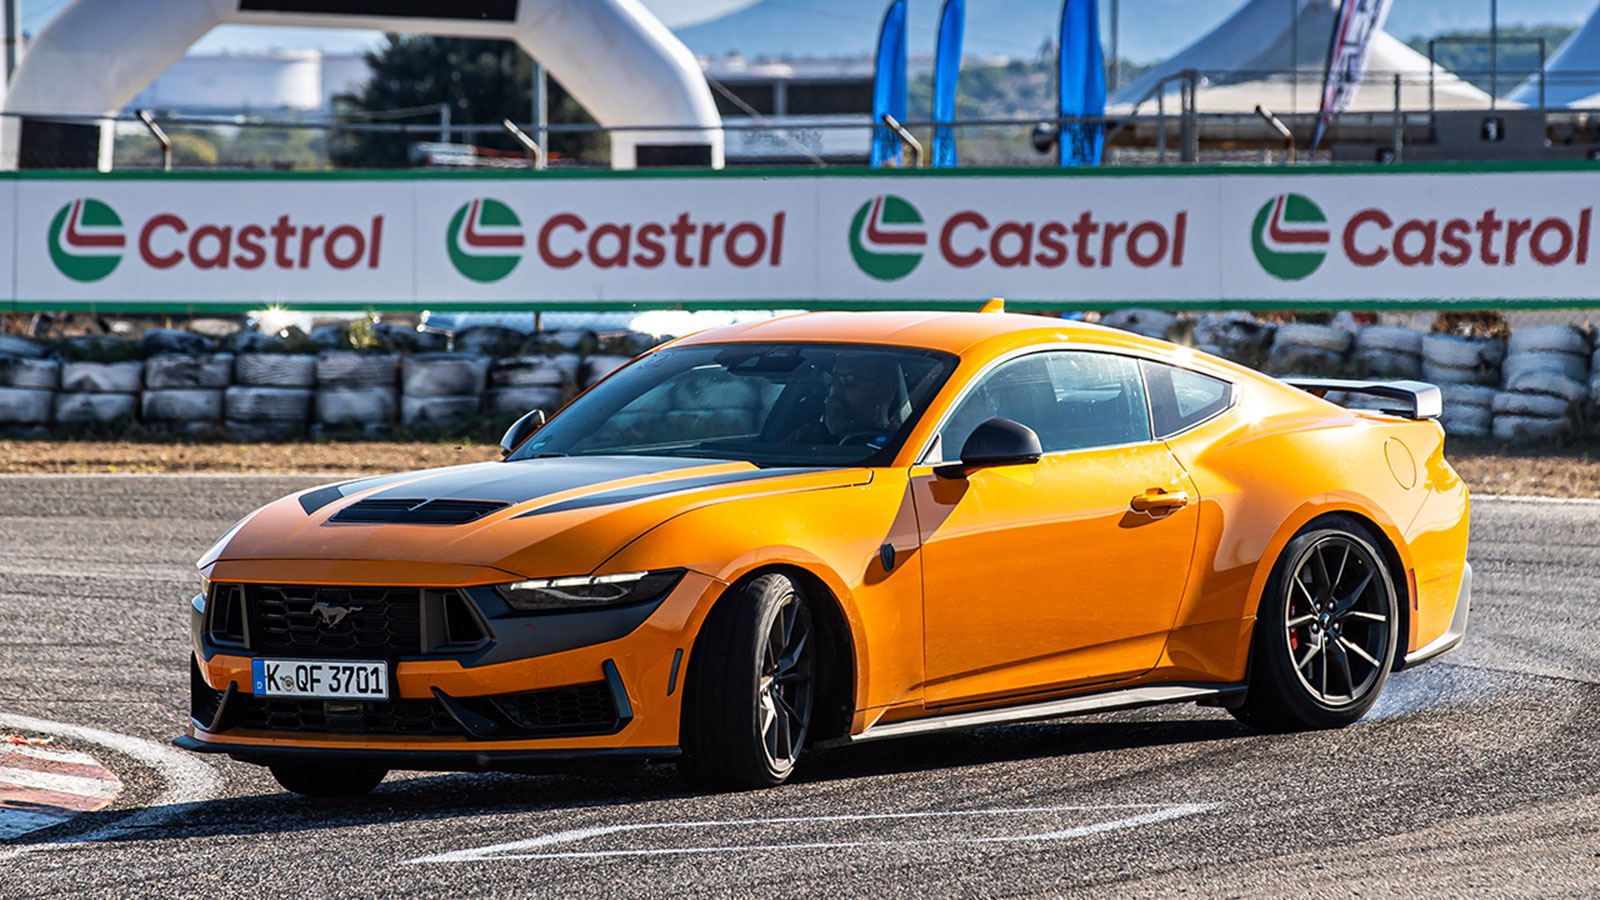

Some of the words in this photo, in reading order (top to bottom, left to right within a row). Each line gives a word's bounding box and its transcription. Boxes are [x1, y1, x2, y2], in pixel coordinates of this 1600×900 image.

[139, 214, 382, 270] Castrol
[538, 213, 785, 269] Castrol
[940, 211, 1187, 268] Castrol
[1343, 209, 1590, 266] Castrol
[256, 681, 263, 690] D
[266, 664, 281, 691] K
[295, 664, 322, 692] QF
[328, 666, 383, 694] 3701
